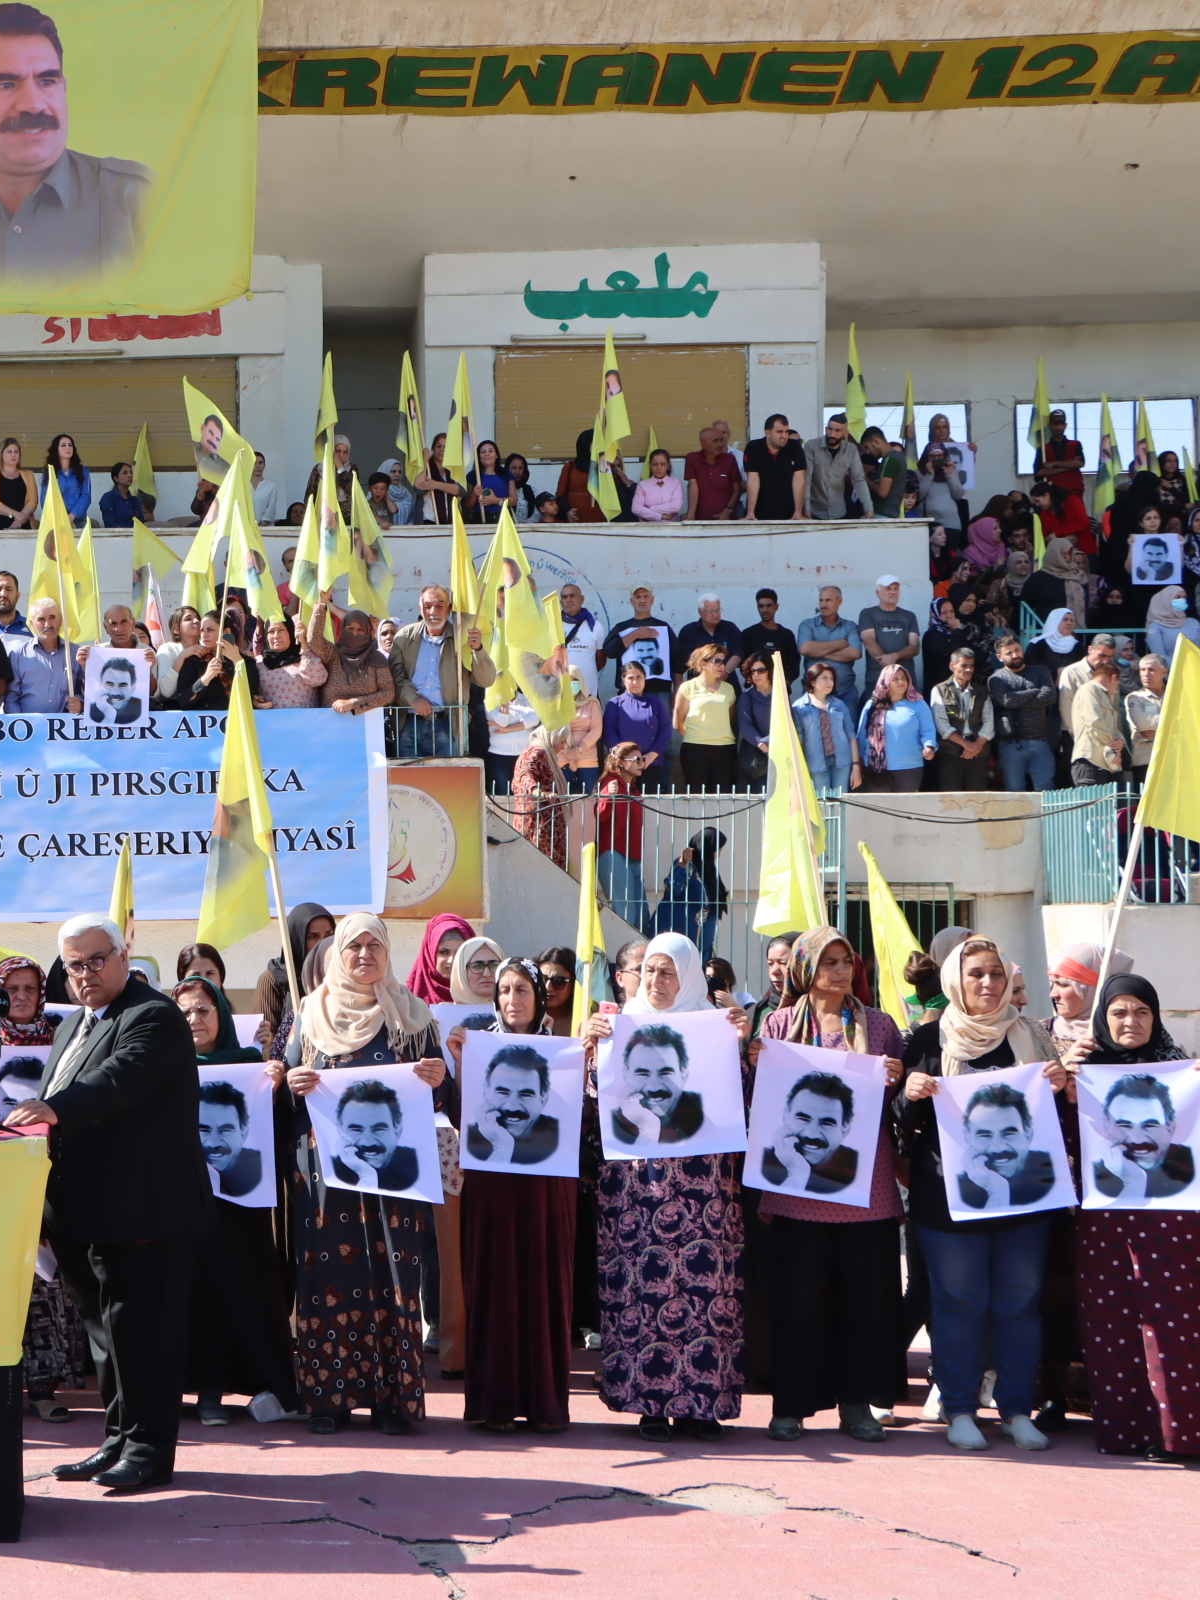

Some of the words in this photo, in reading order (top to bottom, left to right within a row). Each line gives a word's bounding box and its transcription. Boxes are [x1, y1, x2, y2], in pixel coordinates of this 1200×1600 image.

[523, 251, 719, 332] ملعب
[15, 767, 41, 798] Û
[48, 773, 77, 804] JI
